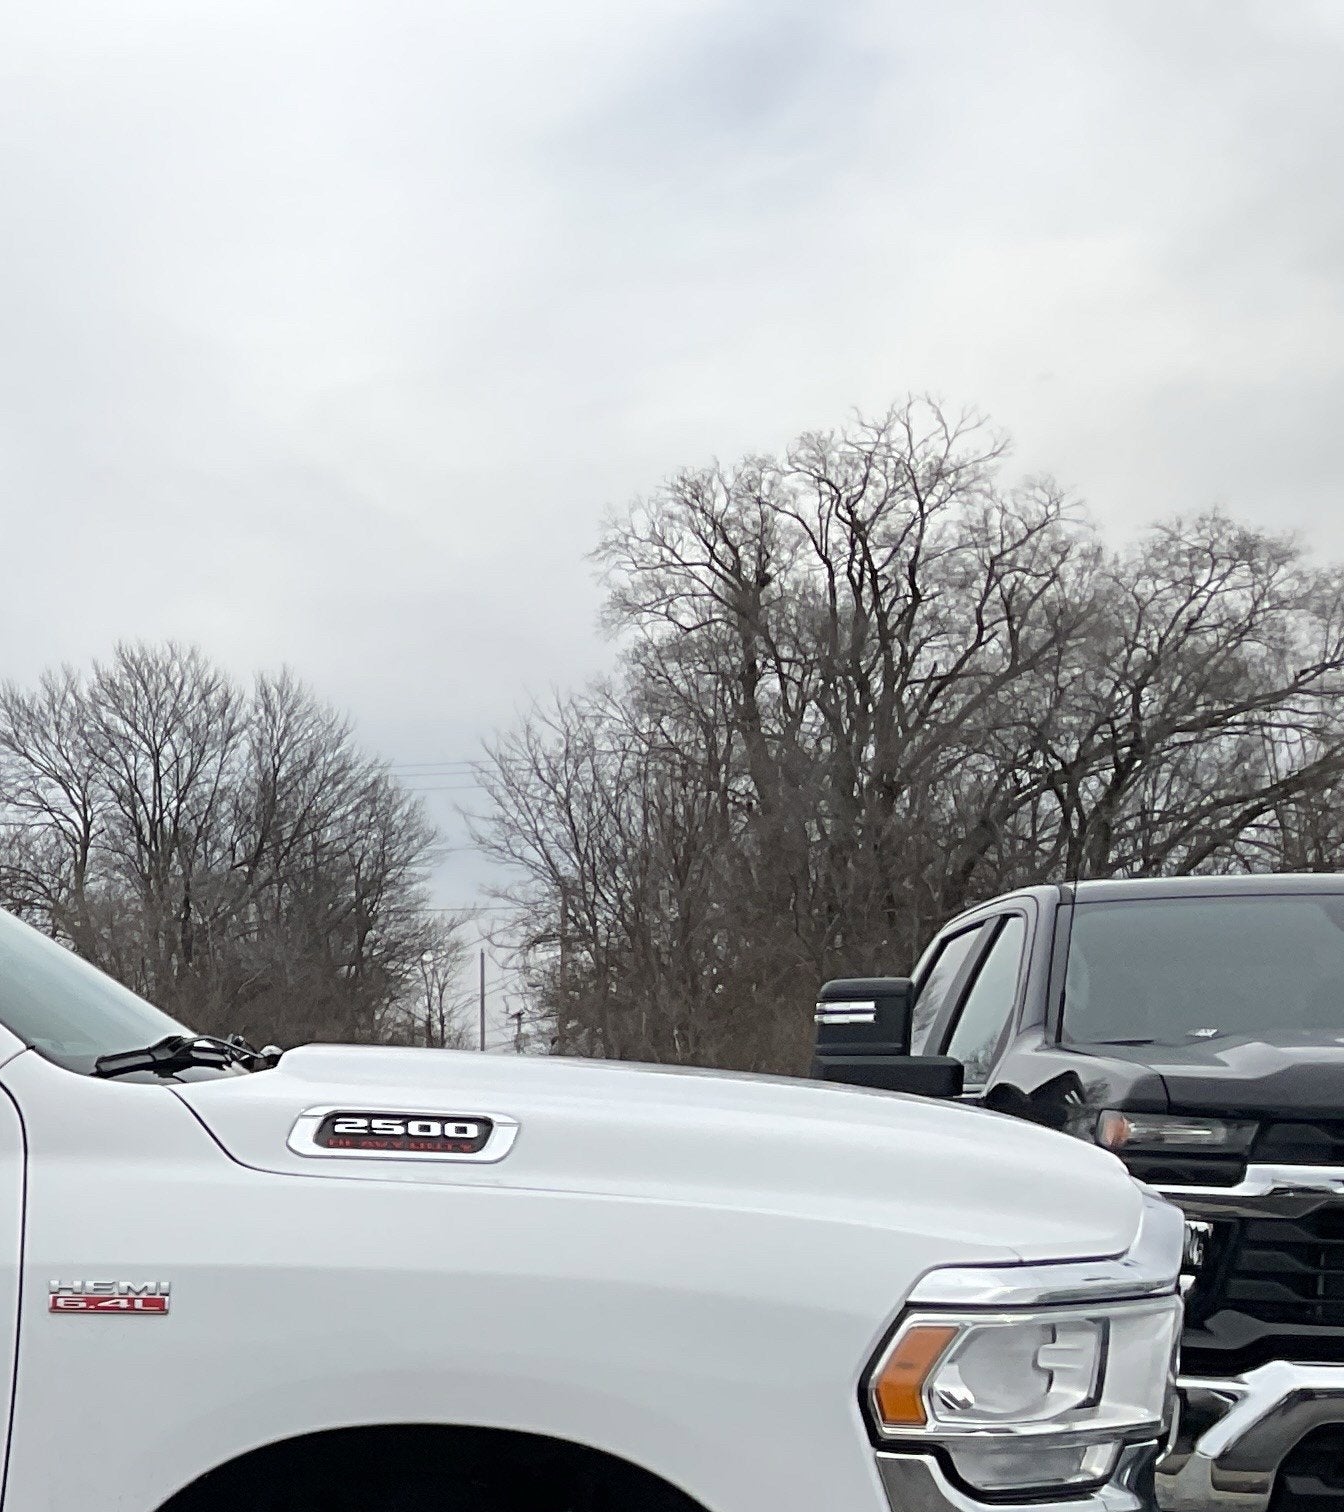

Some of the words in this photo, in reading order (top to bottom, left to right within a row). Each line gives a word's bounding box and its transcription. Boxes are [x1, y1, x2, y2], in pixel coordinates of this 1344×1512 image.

[333, 1117, 479, 1139] 2500
[49, 1279, 172, 1296] HEMI
[55, 1297, 161, 1311] 6.4L
